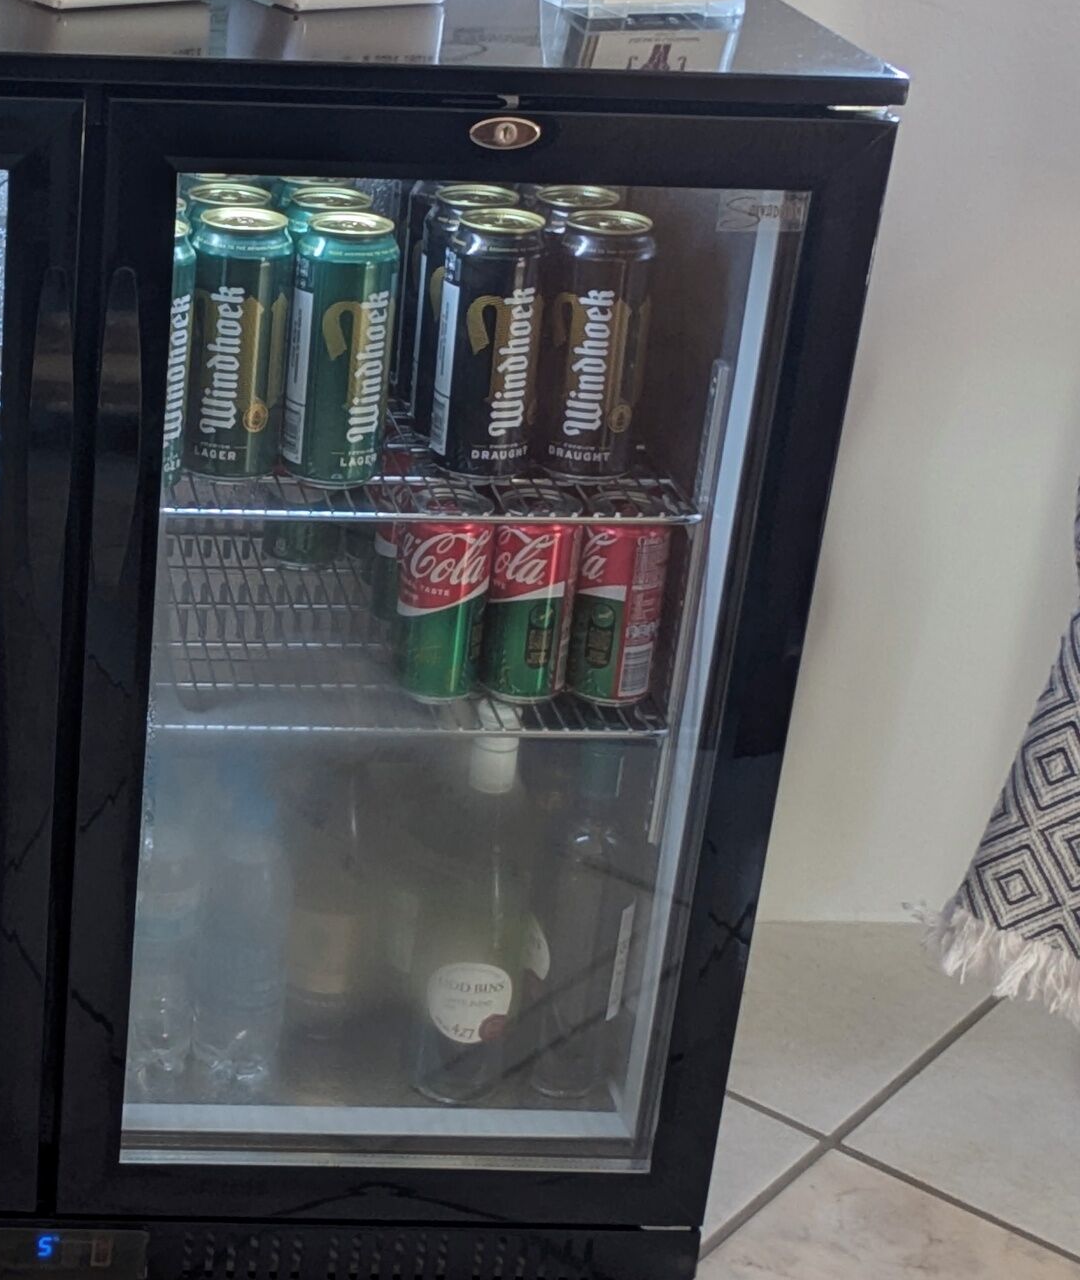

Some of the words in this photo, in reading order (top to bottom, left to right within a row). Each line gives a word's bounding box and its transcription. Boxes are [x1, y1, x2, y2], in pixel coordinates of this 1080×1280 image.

[199, 286, 246, 434] Windhoek
[346, 289, 390, 444] Windhoek
[488, 286, 536, 437] Windhoek
[562, 288, 616, 437] Windhoek
[193, 444, 237, 461] LAGER
[339, 453, 378, 468] LAGER
[471, 445, 529, 461] DRAUGHT
[548, 444, 611, 462] DRAUGHT
[473, 983, 505, 994] BINS
